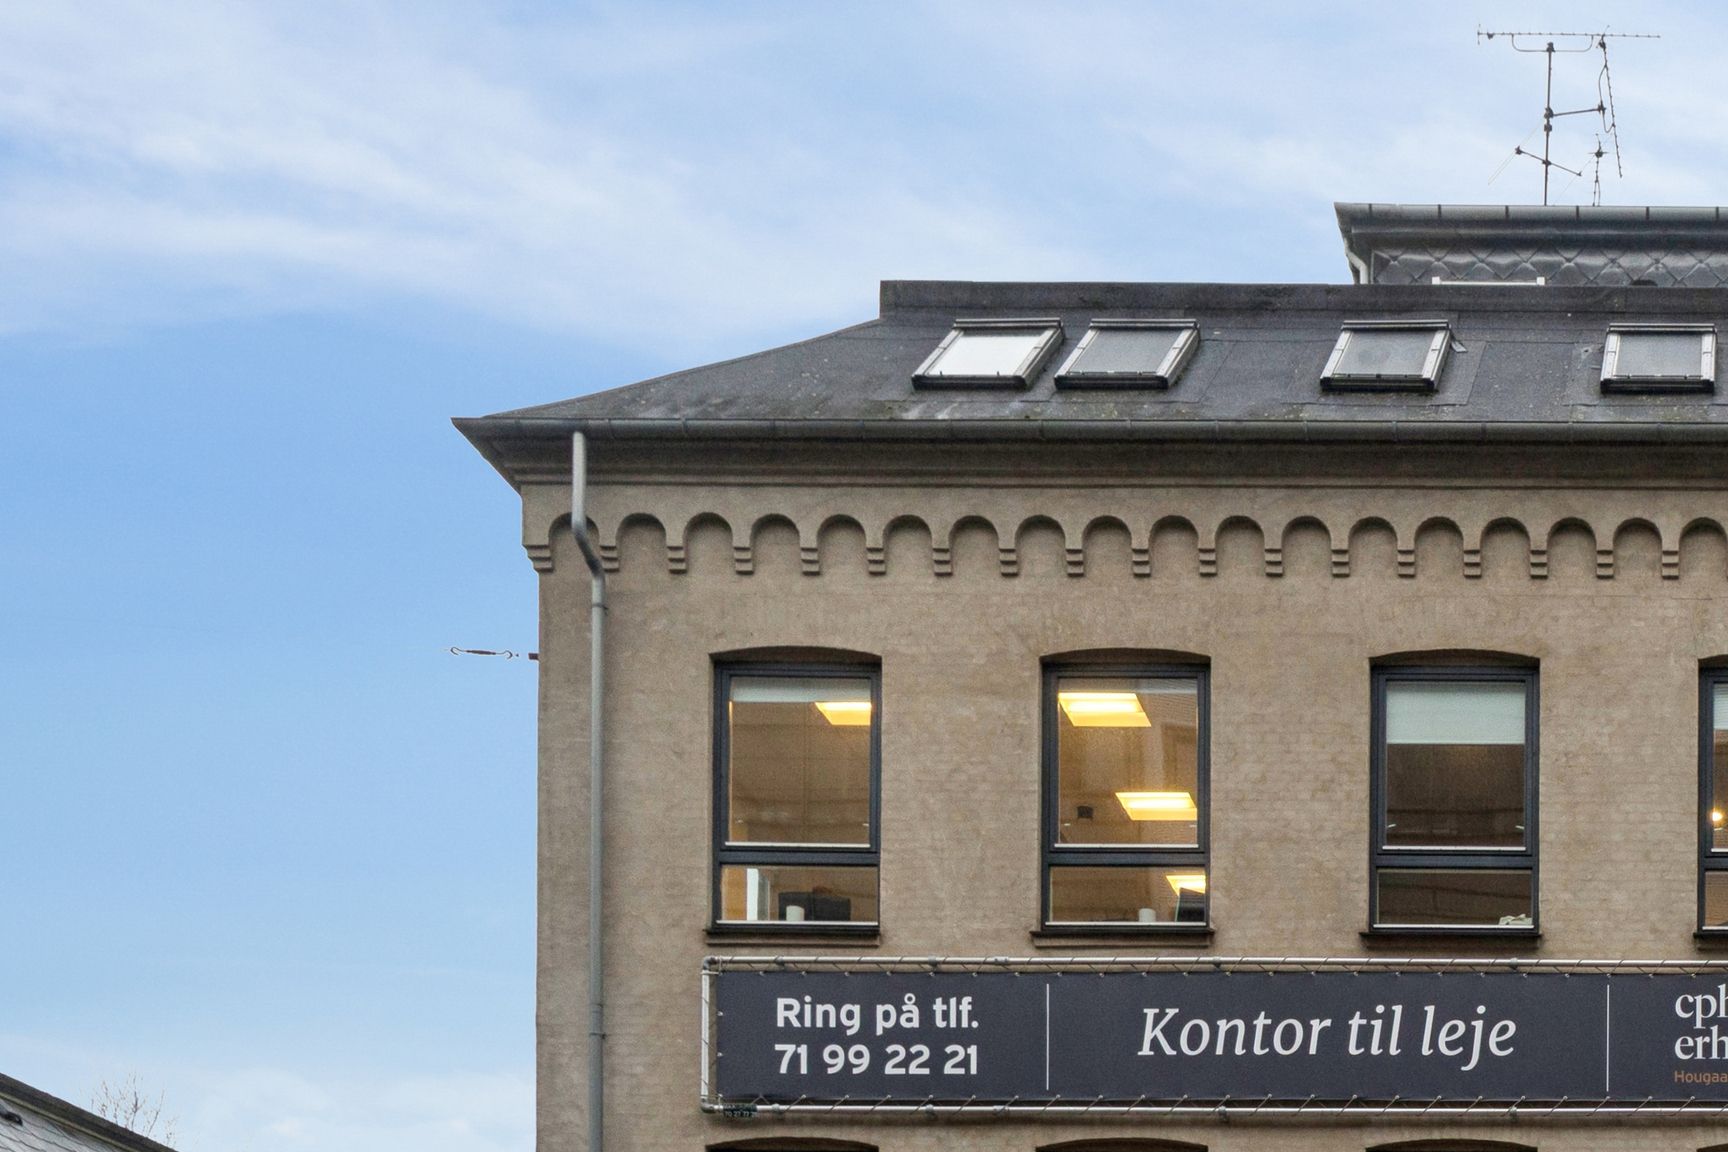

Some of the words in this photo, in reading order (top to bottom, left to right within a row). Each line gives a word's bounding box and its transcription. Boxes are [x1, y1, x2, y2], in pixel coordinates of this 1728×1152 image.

[776, 995, 861, 1035] Ring
[875, 992, 920, 1035] på
[932, 995, 979, 1029] tlf.
[774, 1043, 808, 1075] 71
[822, 1043, 871, 1075] 99
[884, 1043, 931, 1075] 22
[943, 1043, 978, 1075] 21
[1137, 1007, 1332, 1056] Kontor
[1348, 1004, 1403, 1056] til
[1421, 1004, 1517, 1071] leje
